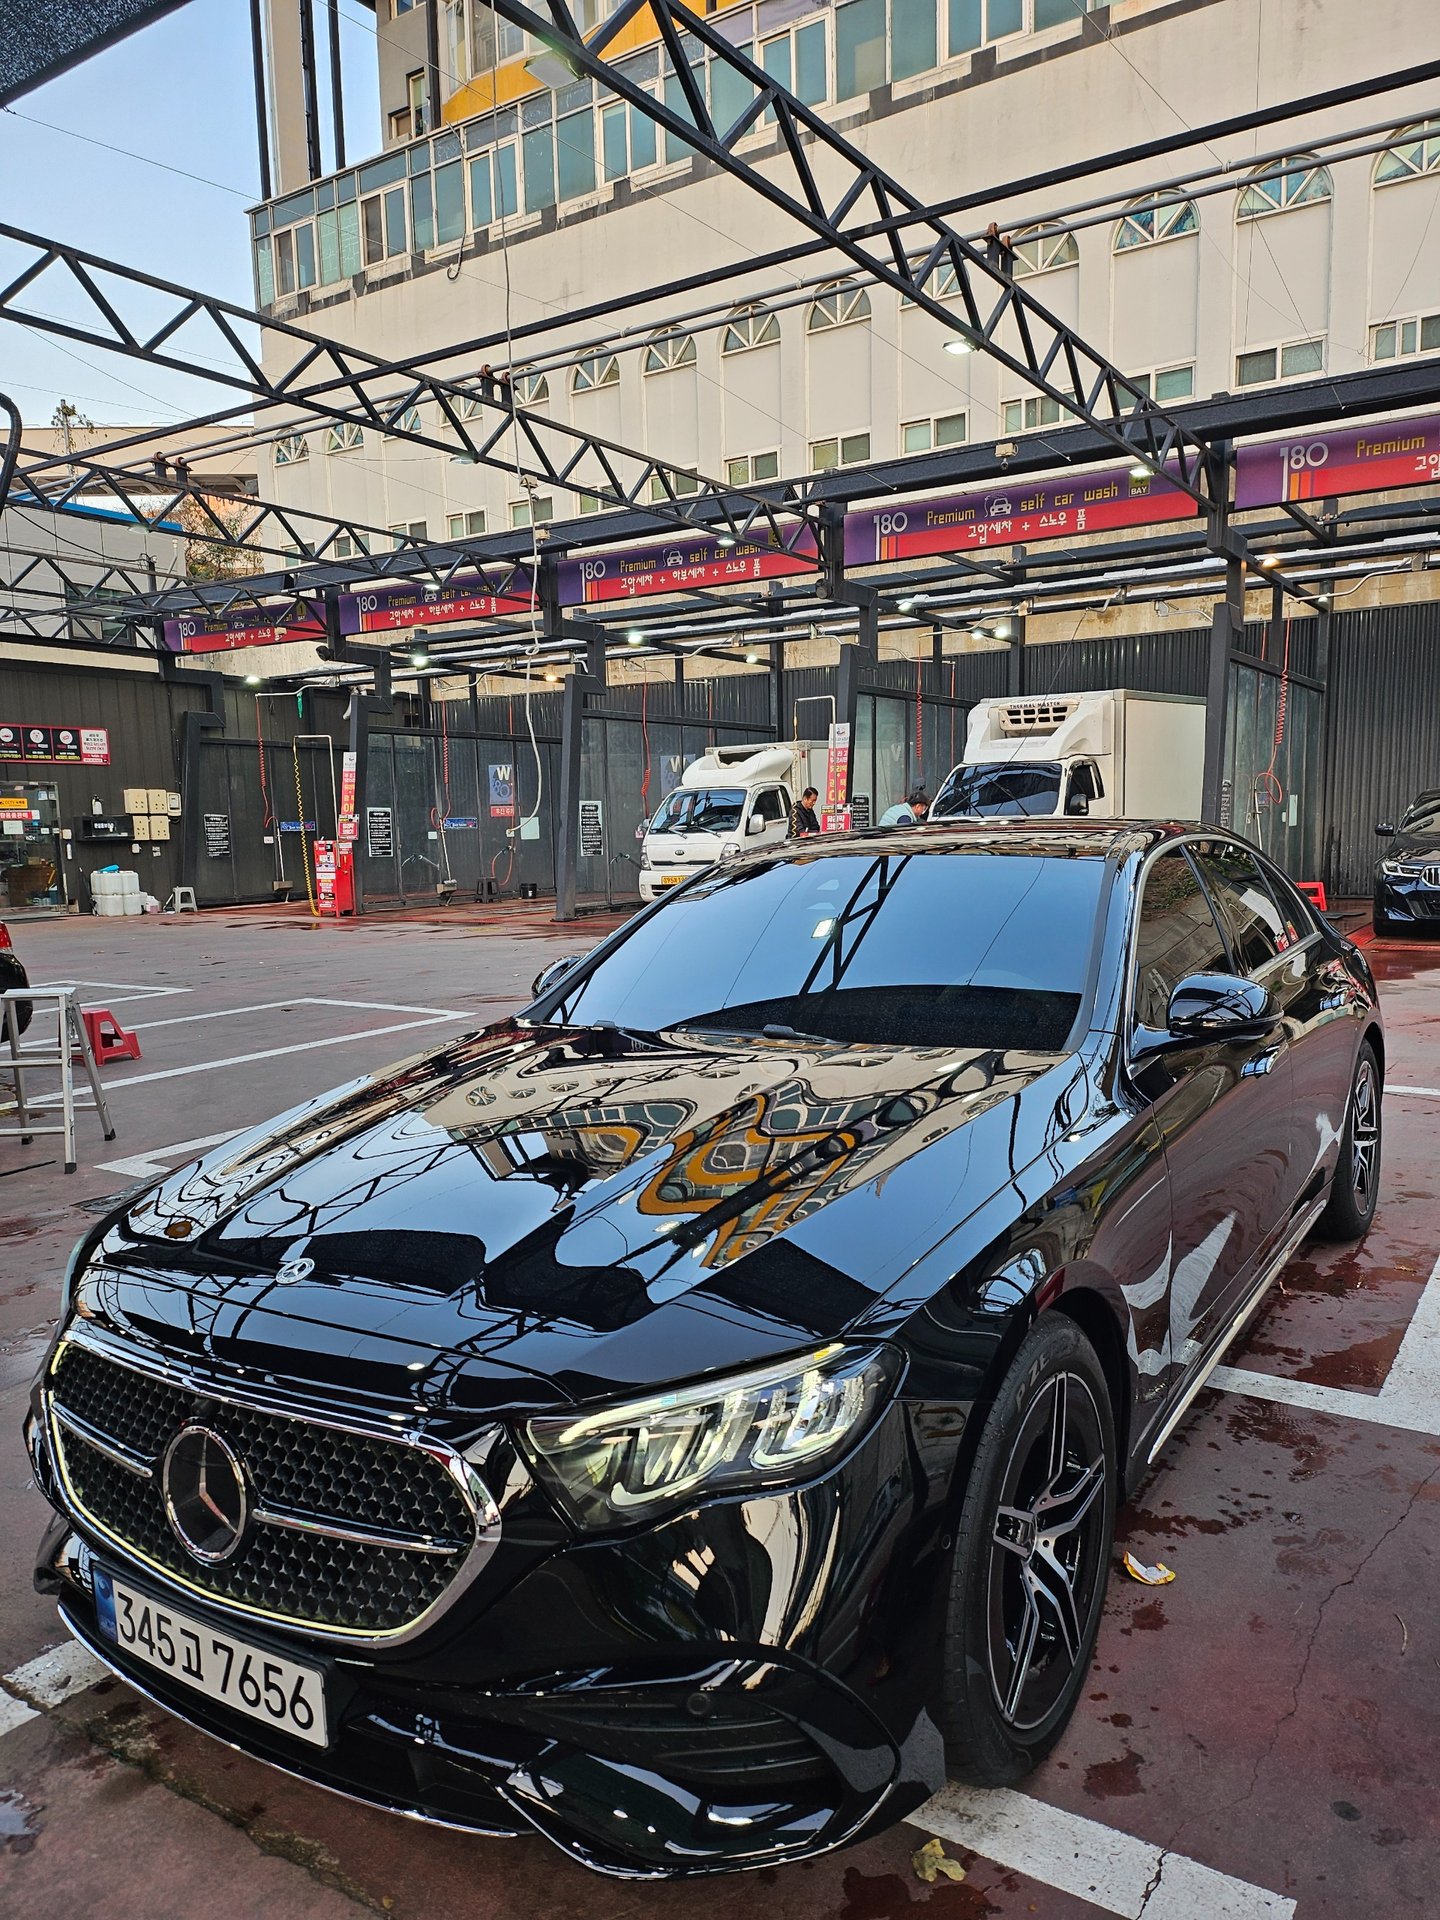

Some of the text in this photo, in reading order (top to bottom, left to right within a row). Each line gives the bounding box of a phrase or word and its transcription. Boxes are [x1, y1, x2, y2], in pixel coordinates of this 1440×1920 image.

[1356, 436, 1425, 457] Premium
[927, 481, 1118, 526] Premium self car wash
[1131, 486, 1147, 495] BAY
[968, 520, 1012, 544] 고압세차
[1039, 512, 1067, 527] 스노우
[1077, 508, 1086, 531] 폼
[620, 558, 656, 573] Premium
[689, 547, 708, 562] self
[714, 548, 728, 559] car
[621, 574, 653, 594] 고압세차
[672, 566, 705, 581] 하부세차
[725, 560, 746, 574] 스노우
[753, 558, 761, 577] 폼
[388, 595, 416, 607] Premium
[389, 609, 414, 626] 고압세차
[117, 1592, 314, 1730] 345고 7656
